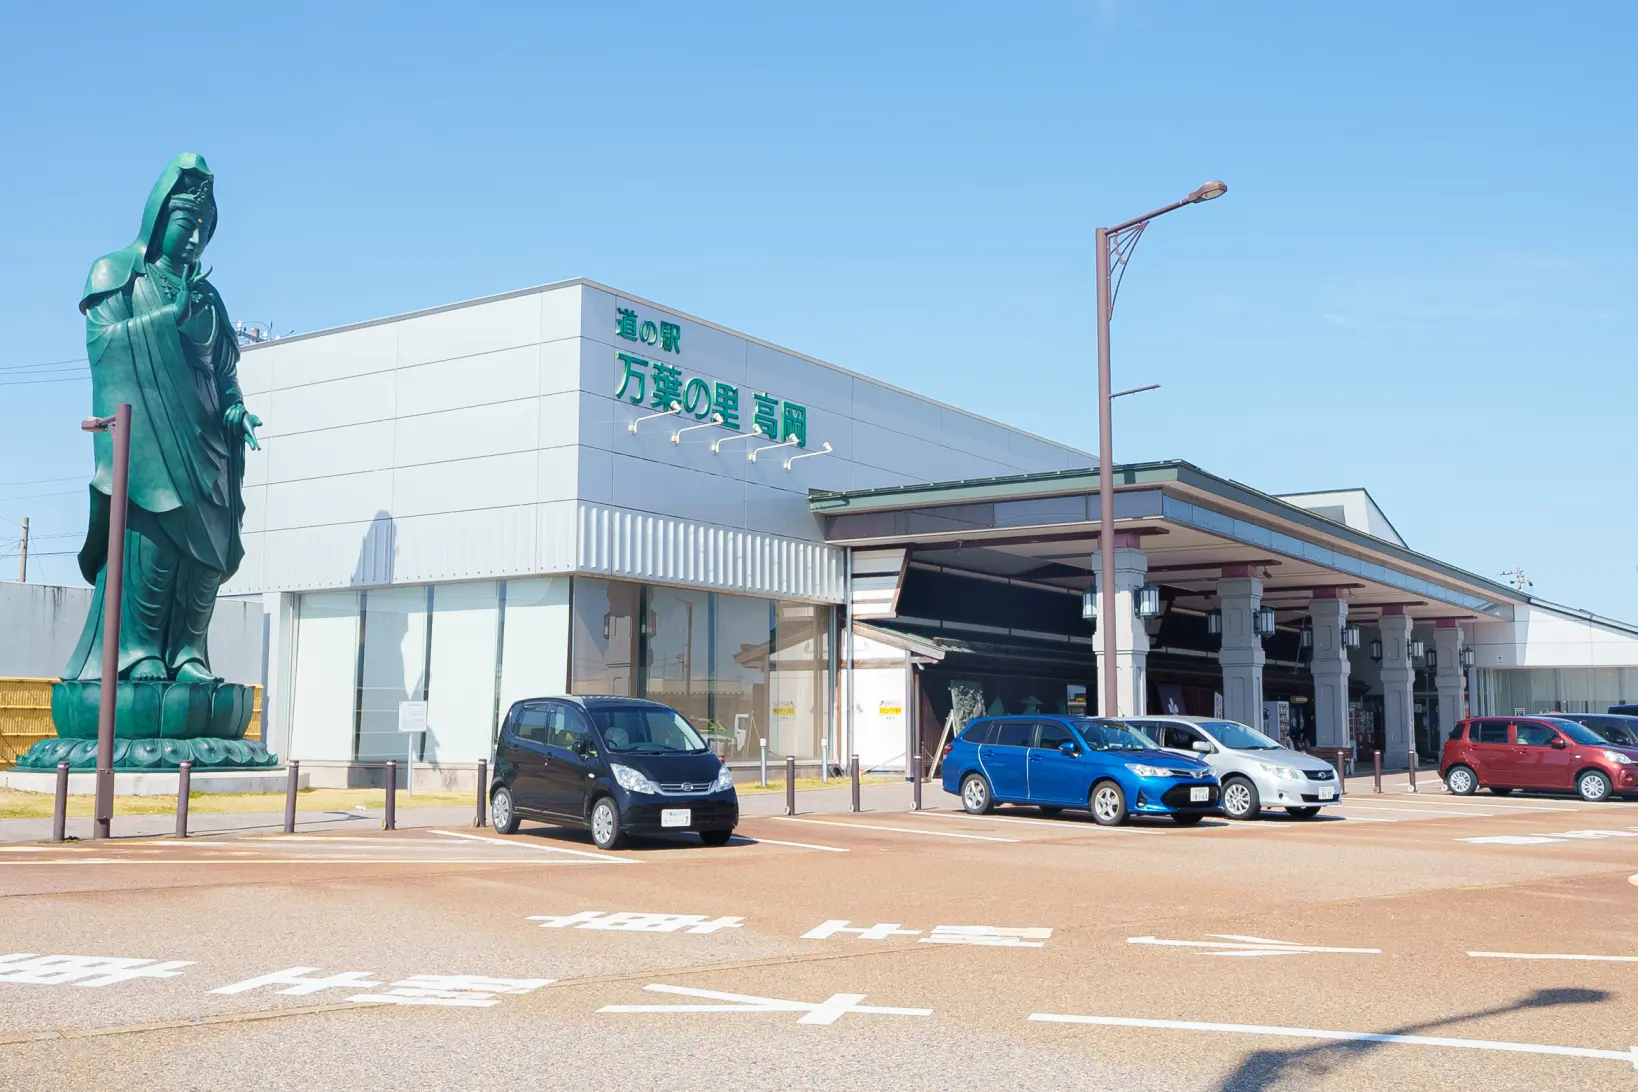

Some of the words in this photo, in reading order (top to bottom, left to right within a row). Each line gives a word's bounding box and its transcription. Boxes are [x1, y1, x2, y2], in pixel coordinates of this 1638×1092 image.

[616, 307, 681, 354] 道の駅
[616, 352, 741, 429] 万葉の里
[752, 391, 807, 449] 高岡
